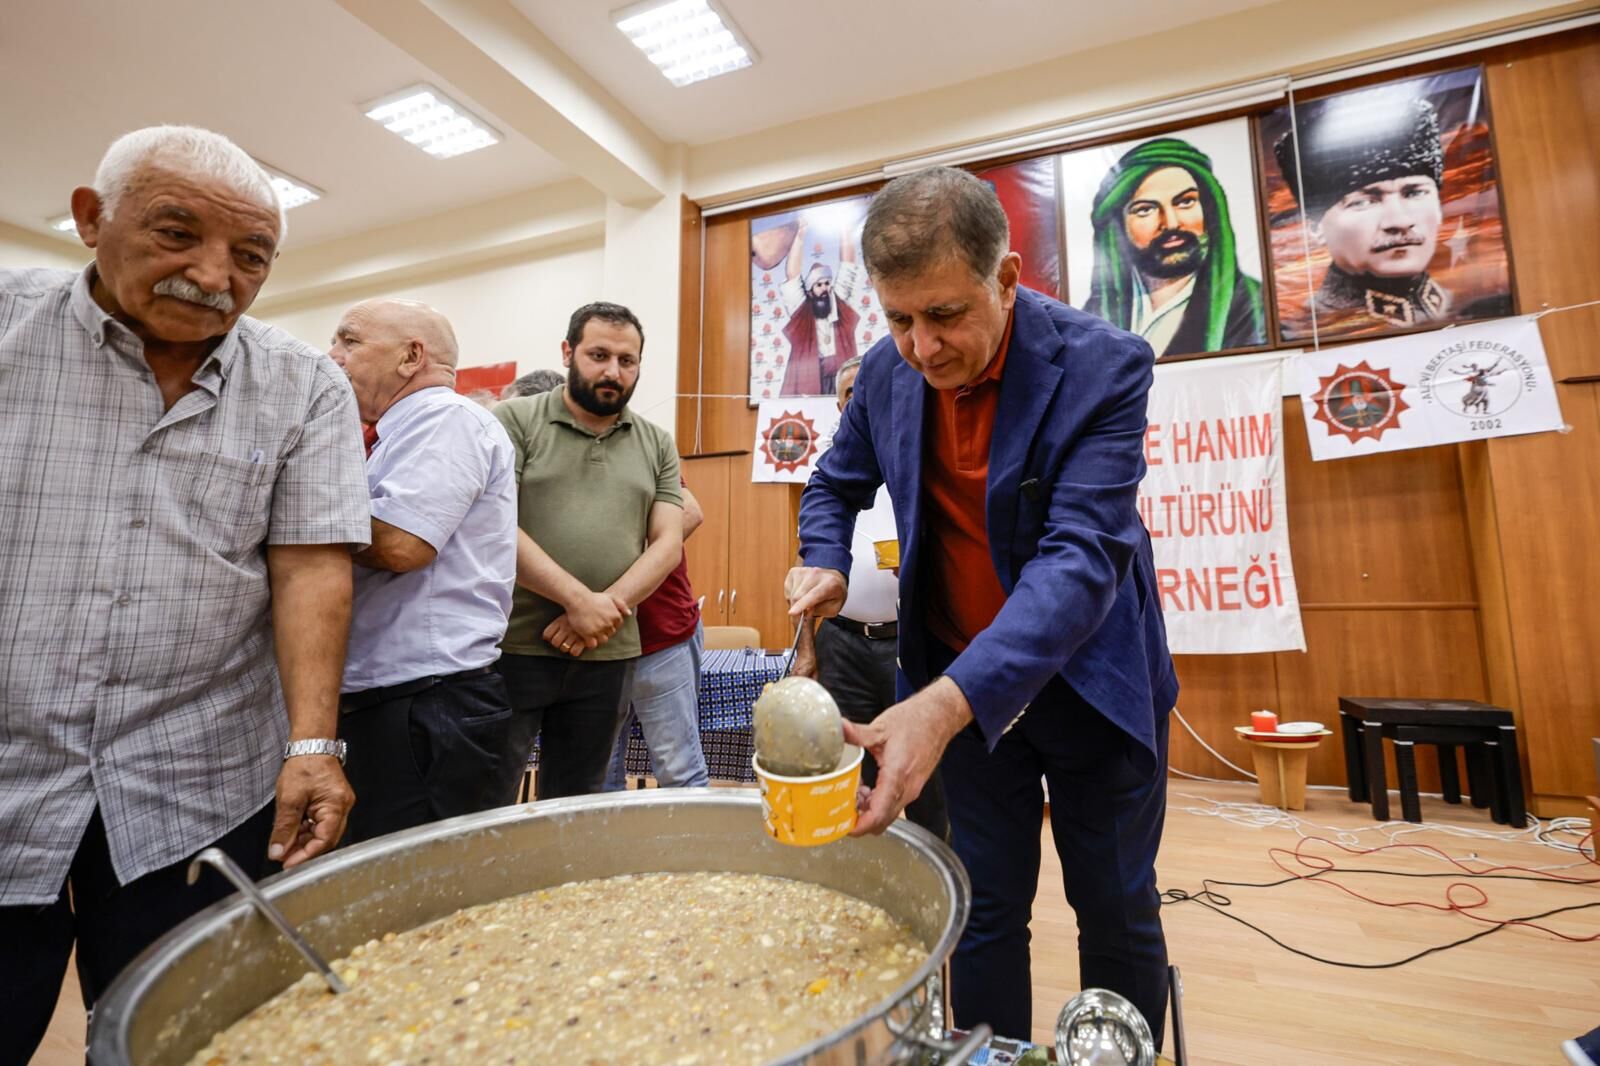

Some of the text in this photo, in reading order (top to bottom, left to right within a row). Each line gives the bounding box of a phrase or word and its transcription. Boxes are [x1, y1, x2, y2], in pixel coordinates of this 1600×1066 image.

[1469, 341, 1537, 388] FEDERASYONU
[1172, 413, 1274, 465] HANIM
[1470, 418, 1502, 431] 2002
